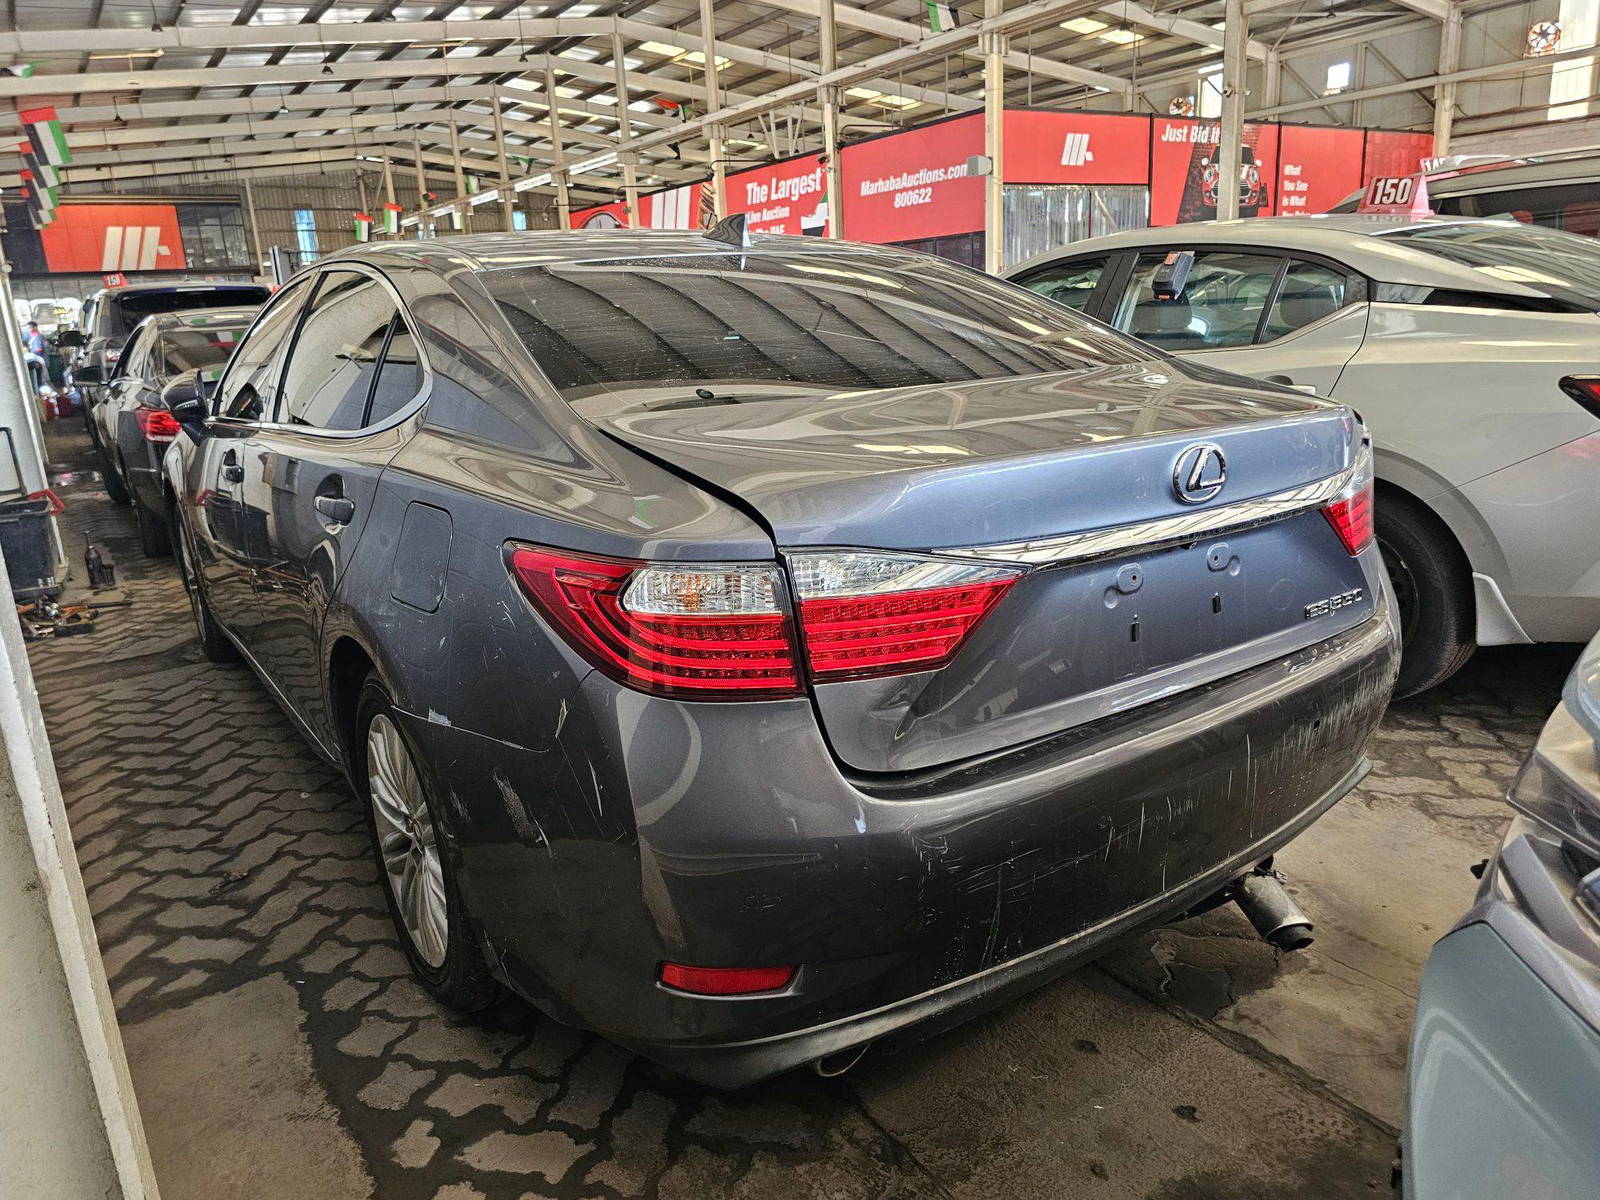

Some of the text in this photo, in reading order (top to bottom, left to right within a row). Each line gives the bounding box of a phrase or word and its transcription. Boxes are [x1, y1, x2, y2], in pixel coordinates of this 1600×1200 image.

[1161, 124, 1188, 142] Just
[1190, 126, 1208, 143] Bid
[746, 168, 822, 205] The Largest
[1284, 181, 1308, 191] You See
[1374, 178, 1412, 205] 150
[895, 187, 932, 208] 800622
[762, 206, 790, 221] Auction
